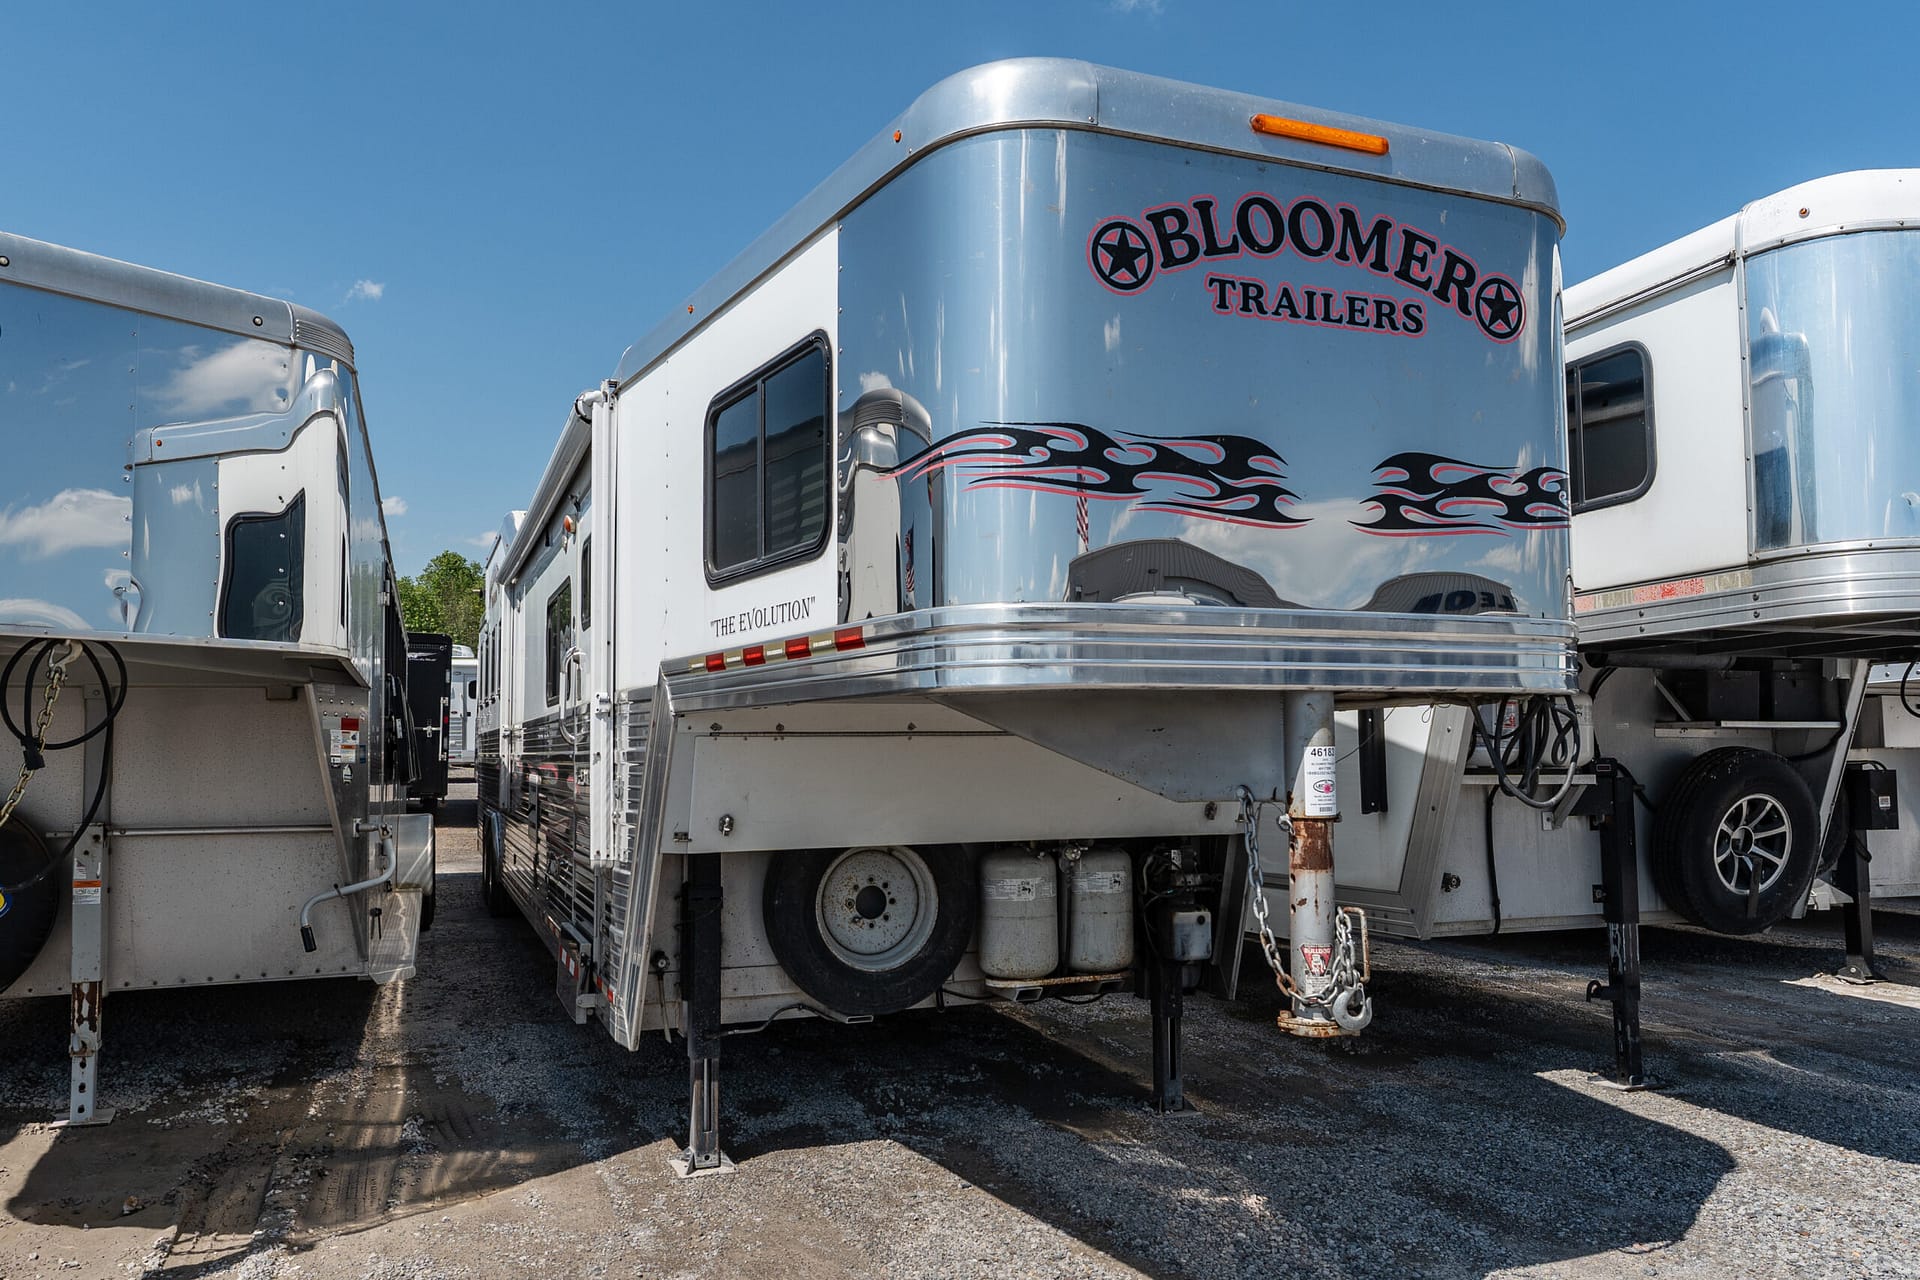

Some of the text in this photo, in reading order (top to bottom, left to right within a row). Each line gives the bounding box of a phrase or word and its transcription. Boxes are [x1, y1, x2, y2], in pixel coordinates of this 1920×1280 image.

[1145, 196, 1477, 317] BLOOMER
[1208, 277, 1424, 334] TRAILERS
[710, 596, 816, 637] "THE EVOLUTION"
